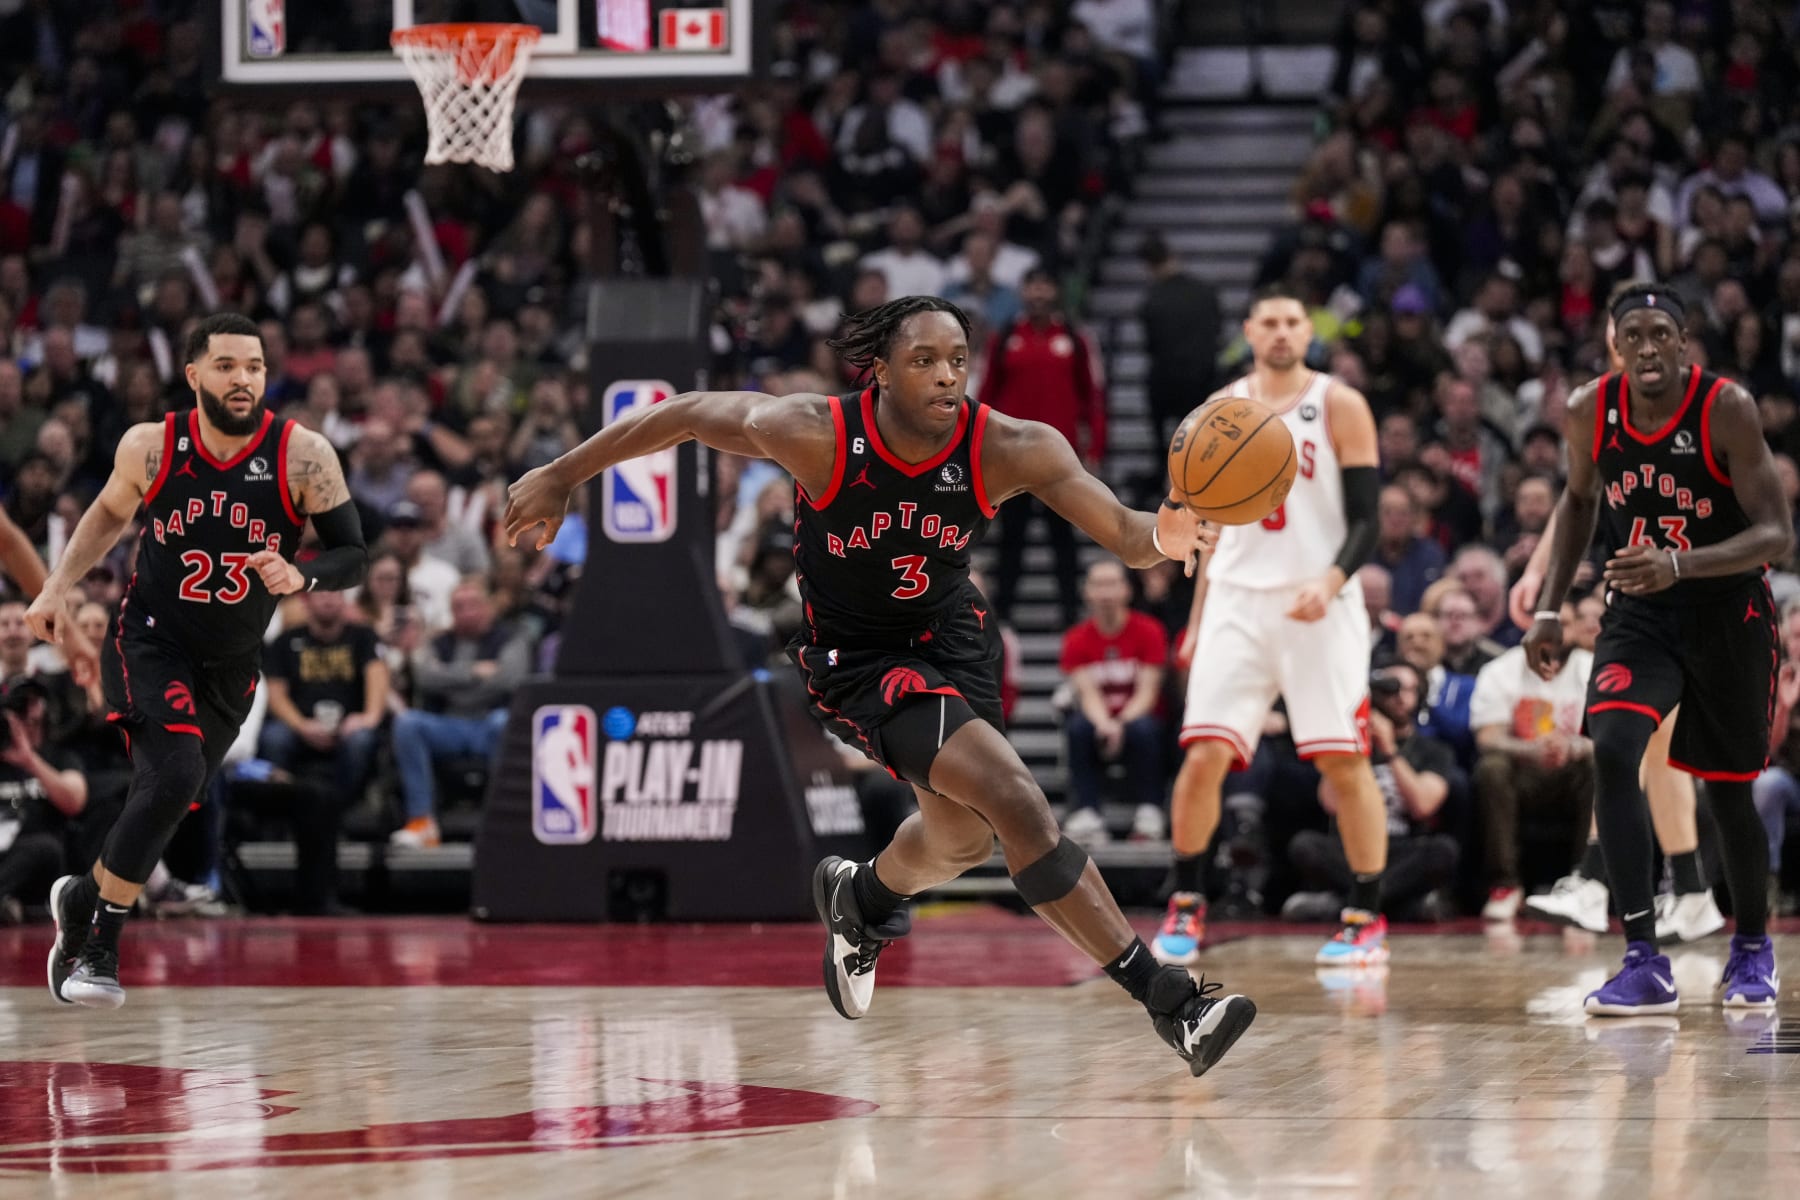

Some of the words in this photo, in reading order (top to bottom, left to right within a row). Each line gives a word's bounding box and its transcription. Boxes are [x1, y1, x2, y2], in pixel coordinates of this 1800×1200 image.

[1607, 408, 1618, 424] 6
[177, 436, 189, 451] 6
[852, 437, 865, 454] 6
[934, 484, 951, 492] Sun
[952, 484, 968, 492] Life
[153, 490, 281, 553] RAPTORS
[827, 501, 973, 558] RAPTORS
[179, 549, 251, 603] 23
[891, 554, 930, 600] 3
[601, 740, 743, 803] PLAY-IN
[602, 803, 738, 841] TOURNAMENT
